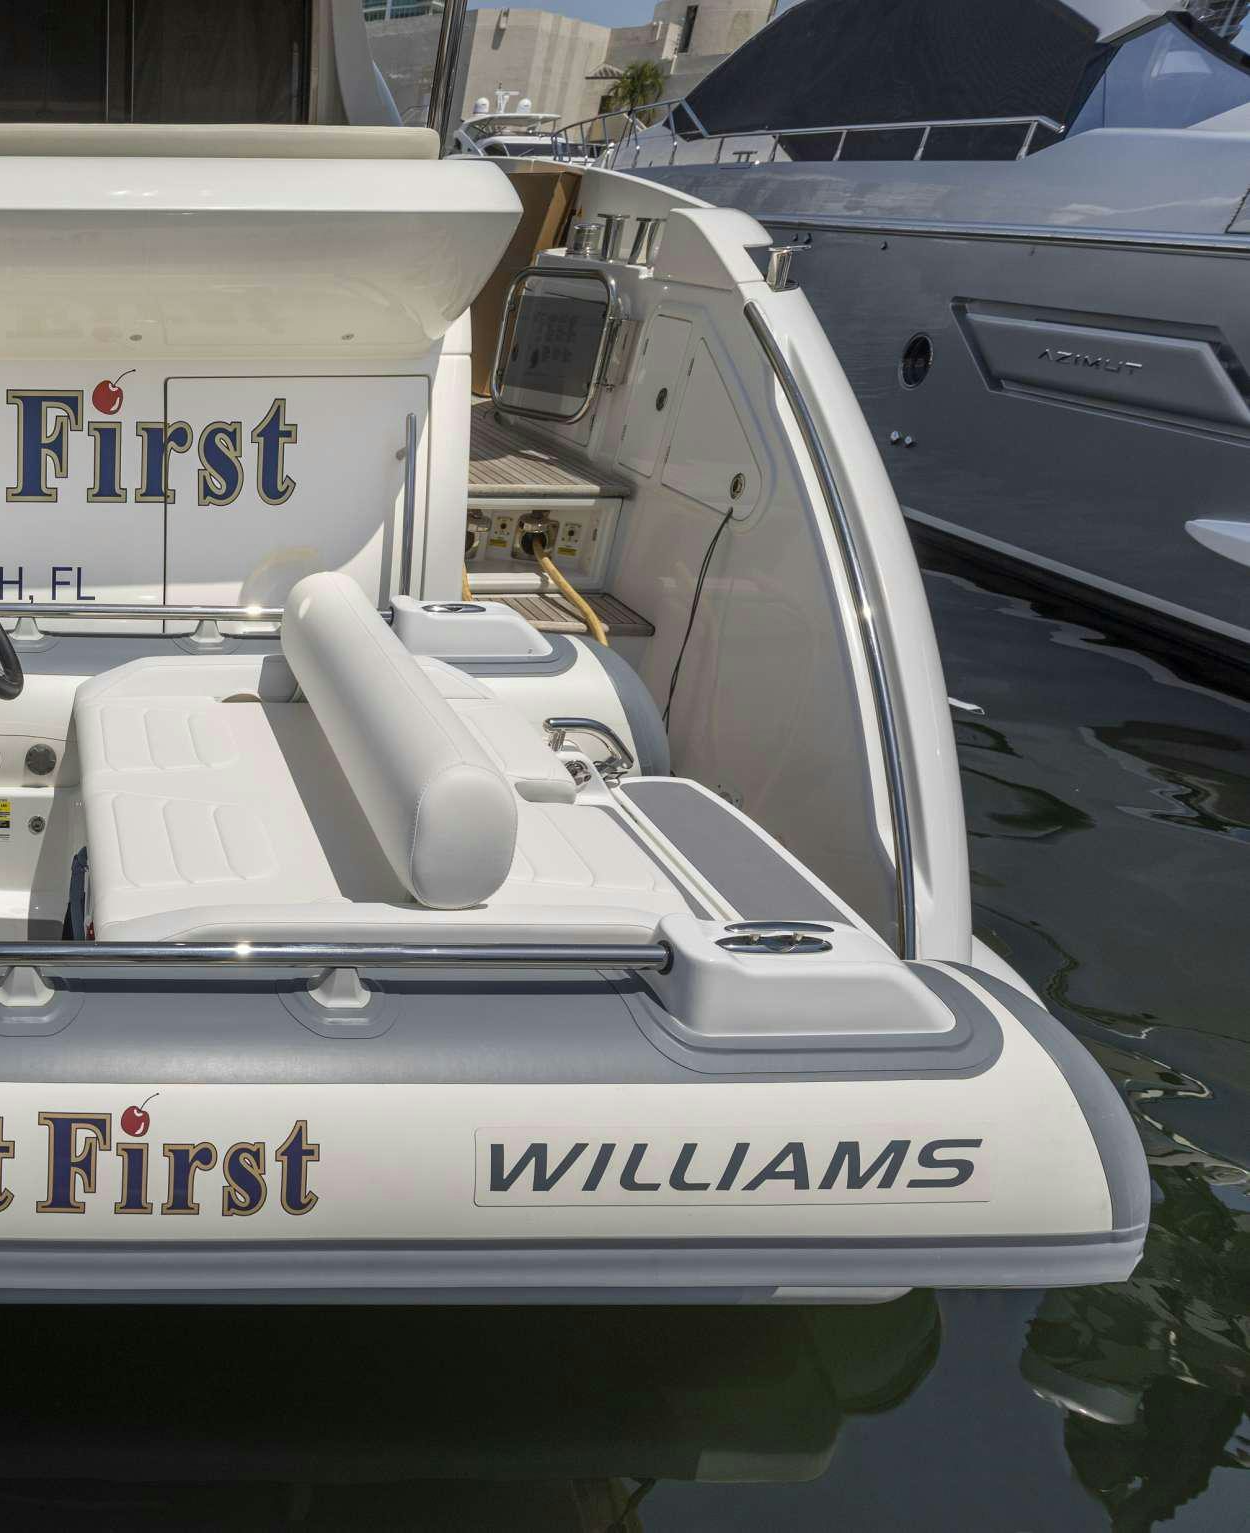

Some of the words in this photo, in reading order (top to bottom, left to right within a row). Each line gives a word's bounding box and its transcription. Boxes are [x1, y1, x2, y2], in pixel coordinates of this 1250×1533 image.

[1037, 348, 1143, 376] AZIMUT
[6, 376, 298, 506] First
[51, 565, 96, 601] FL
[36, 1104, 320, 1216] First
[489, 1138, 983, 1192] WILLIAMS
